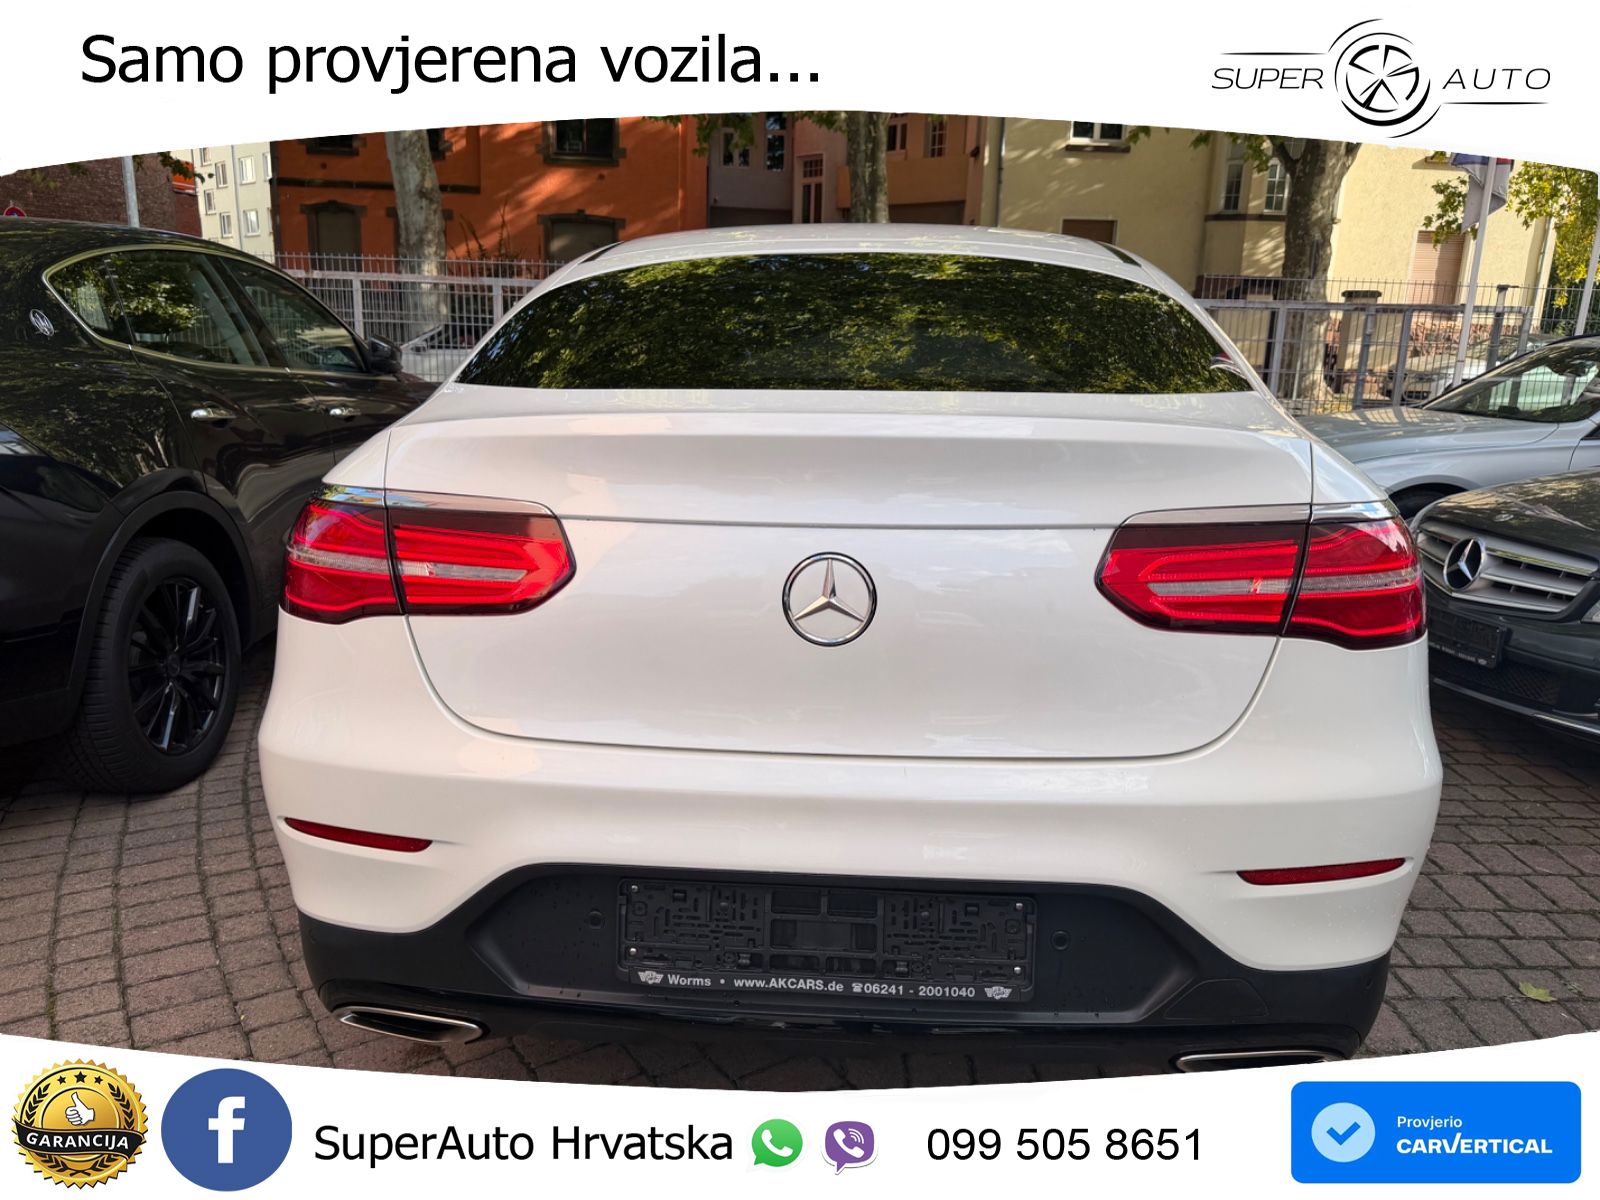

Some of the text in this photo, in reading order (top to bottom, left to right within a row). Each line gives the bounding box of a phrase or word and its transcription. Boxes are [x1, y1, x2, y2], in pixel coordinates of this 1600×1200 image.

[667, 974, 712, 987] Worms
[733, 977, 844, 992] www.AKCARS.de
[864, 983, 904, 996] 06241
[918, 985, 976, 998] 2001040
